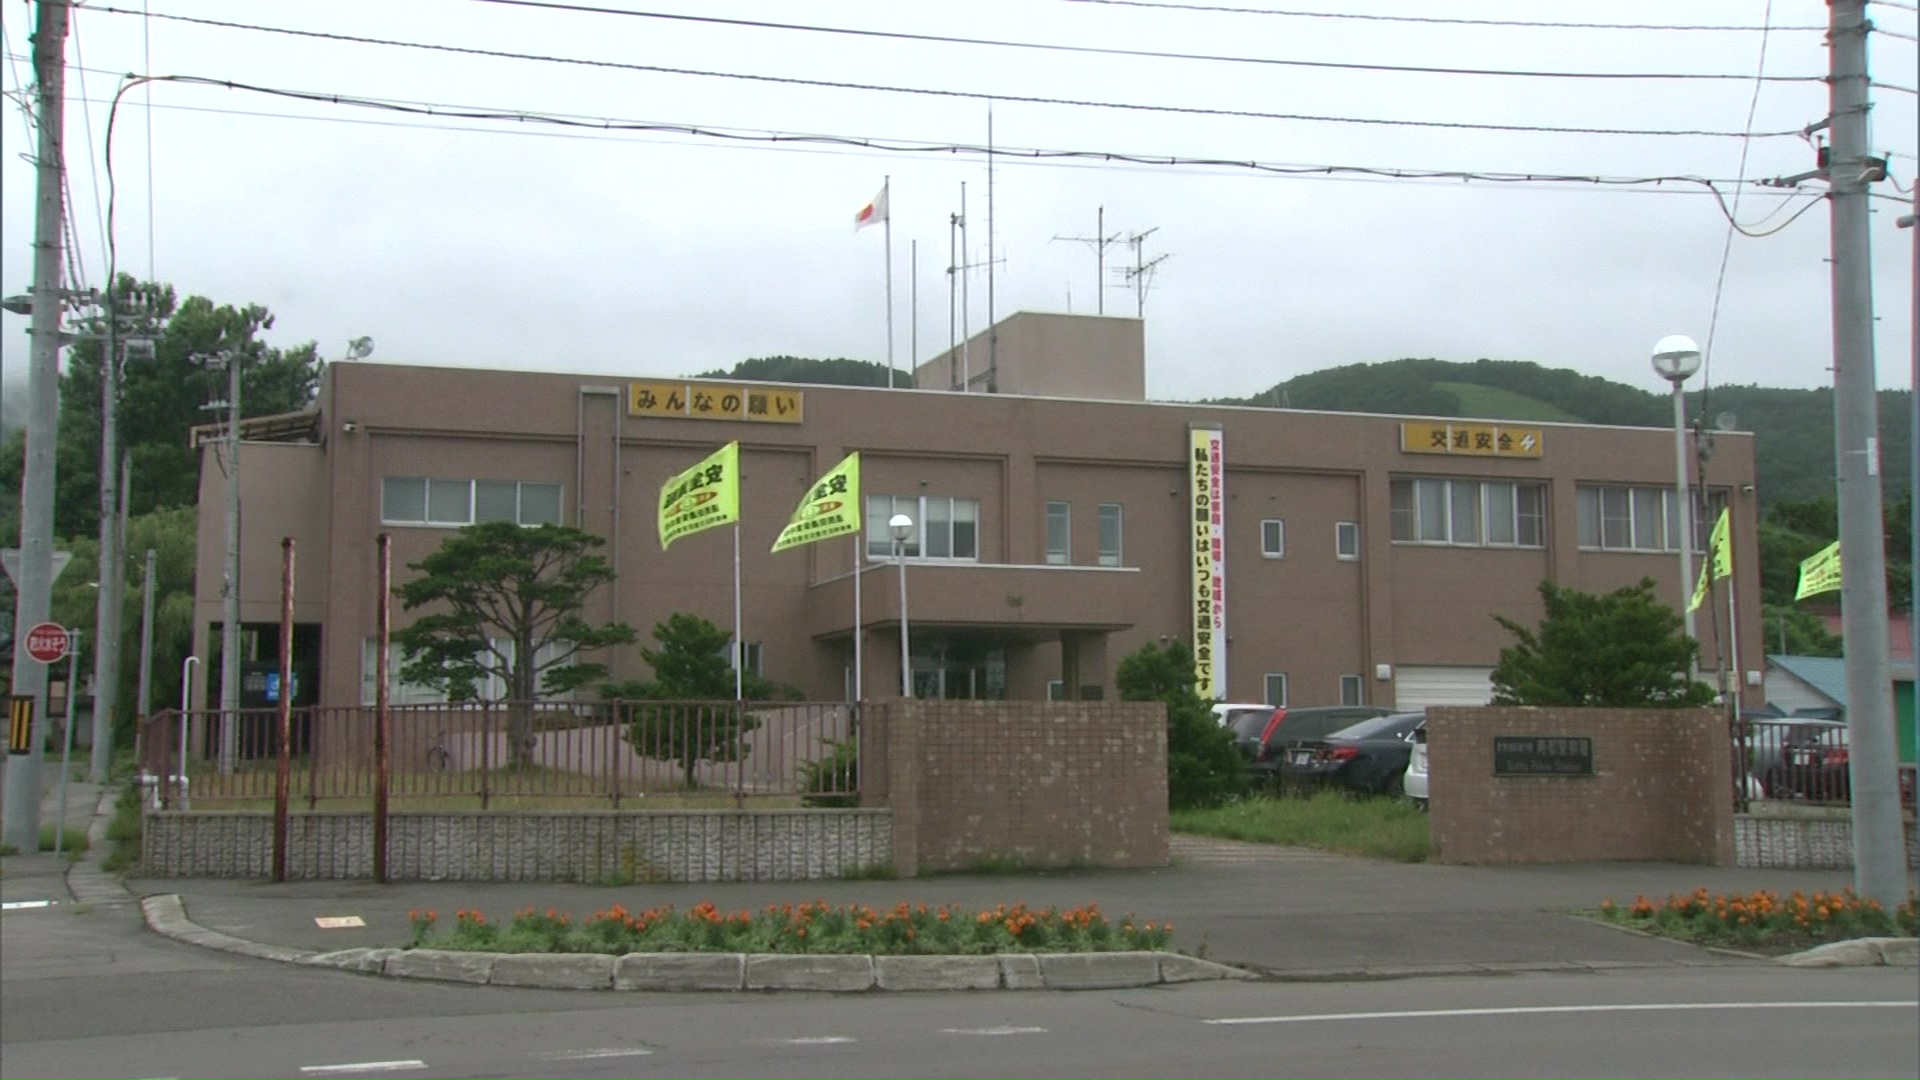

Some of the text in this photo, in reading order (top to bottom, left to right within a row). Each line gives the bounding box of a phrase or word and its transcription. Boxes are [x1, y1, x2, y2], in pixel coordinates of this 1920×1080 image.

[637, 389, 796, 415] みんなの願い
[1430, 430, 1513, 450] 交通安全
[1194, 447, 1212, 691] 私たちの願いはいつも交通安全です
